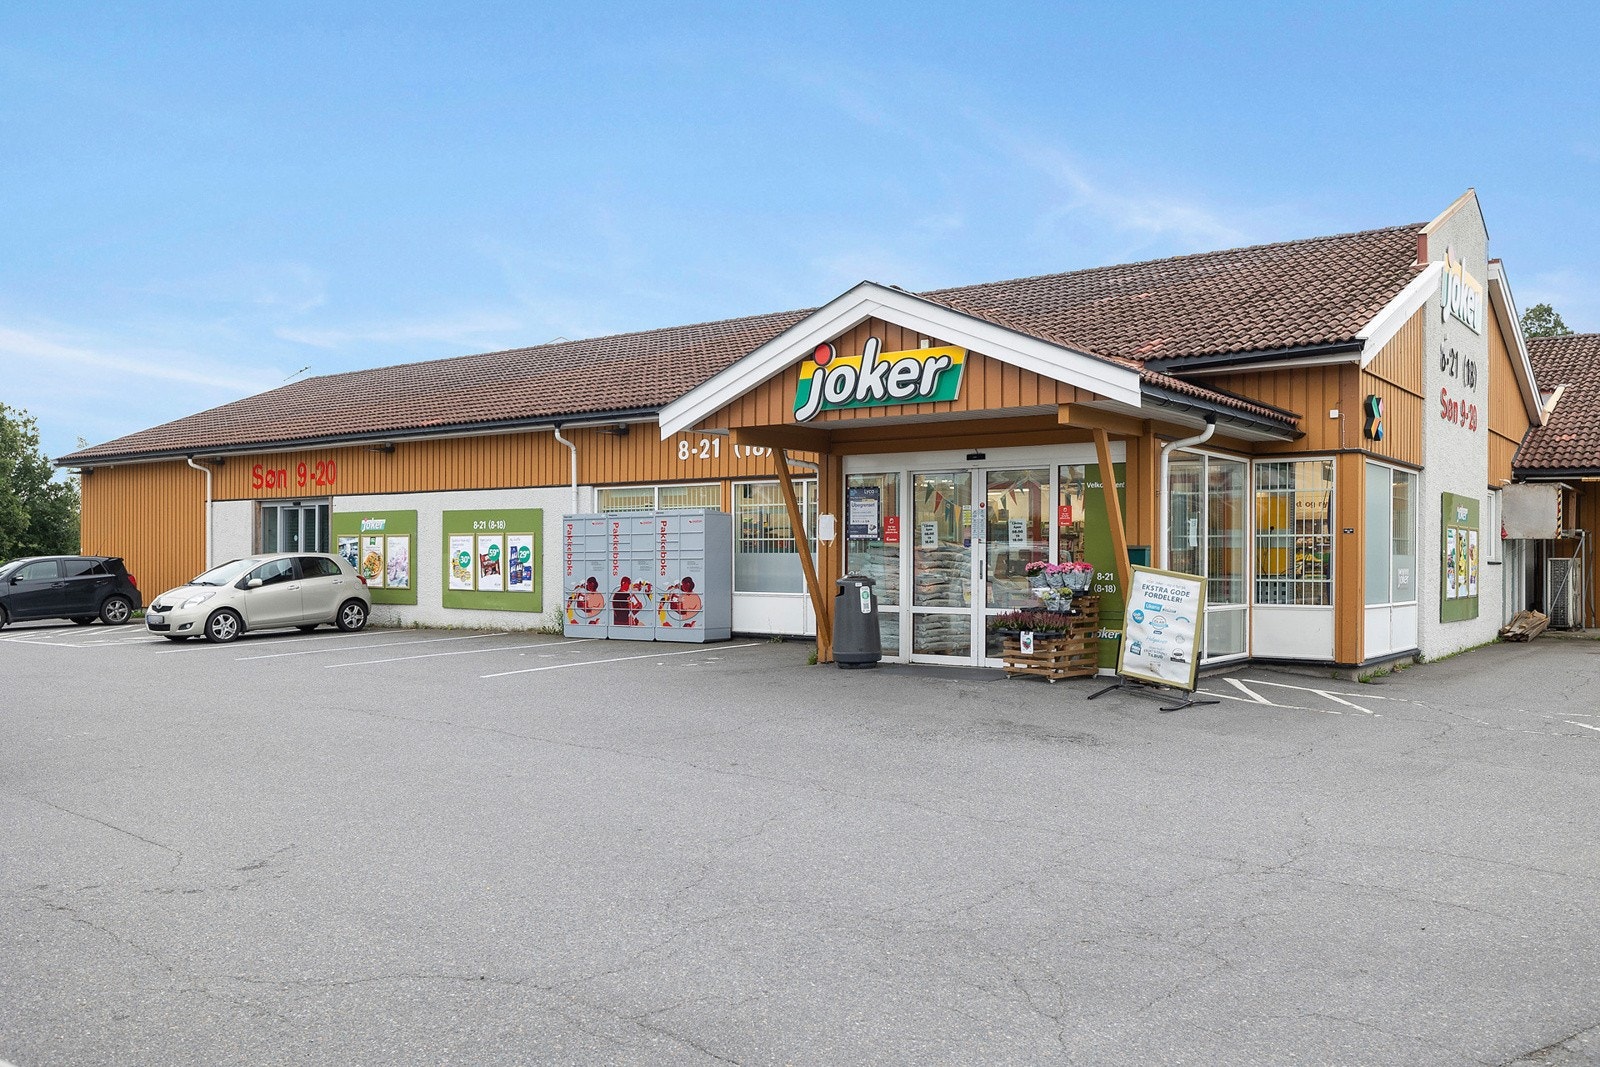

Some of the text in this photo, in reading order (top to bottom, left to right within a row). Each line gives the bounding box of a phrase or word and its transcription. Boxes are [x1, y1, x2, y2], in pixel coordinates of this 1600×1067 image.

[795, 337, 953, 422] joker
[1460, 399, 1478, 432] 9-20
[678, 438, 720, 460] 8-21
[252, 459, 337, 489] Søn 9-20
[473, 520, 506, 530] 8-21 (8-18)
[612, 522, 620, 577] Pakkeboks
[660, 520, 668, 576] Pakkeboks
[1097, 572, 1114, 581] 8-21
[1094, 583, 1116, 594] (8-18)
[1142, 583, 1168, 594] EKSTRA
[1170, 588, 1190, 598] GODE
[1144, 591, 1183, 603] FORDELER!
